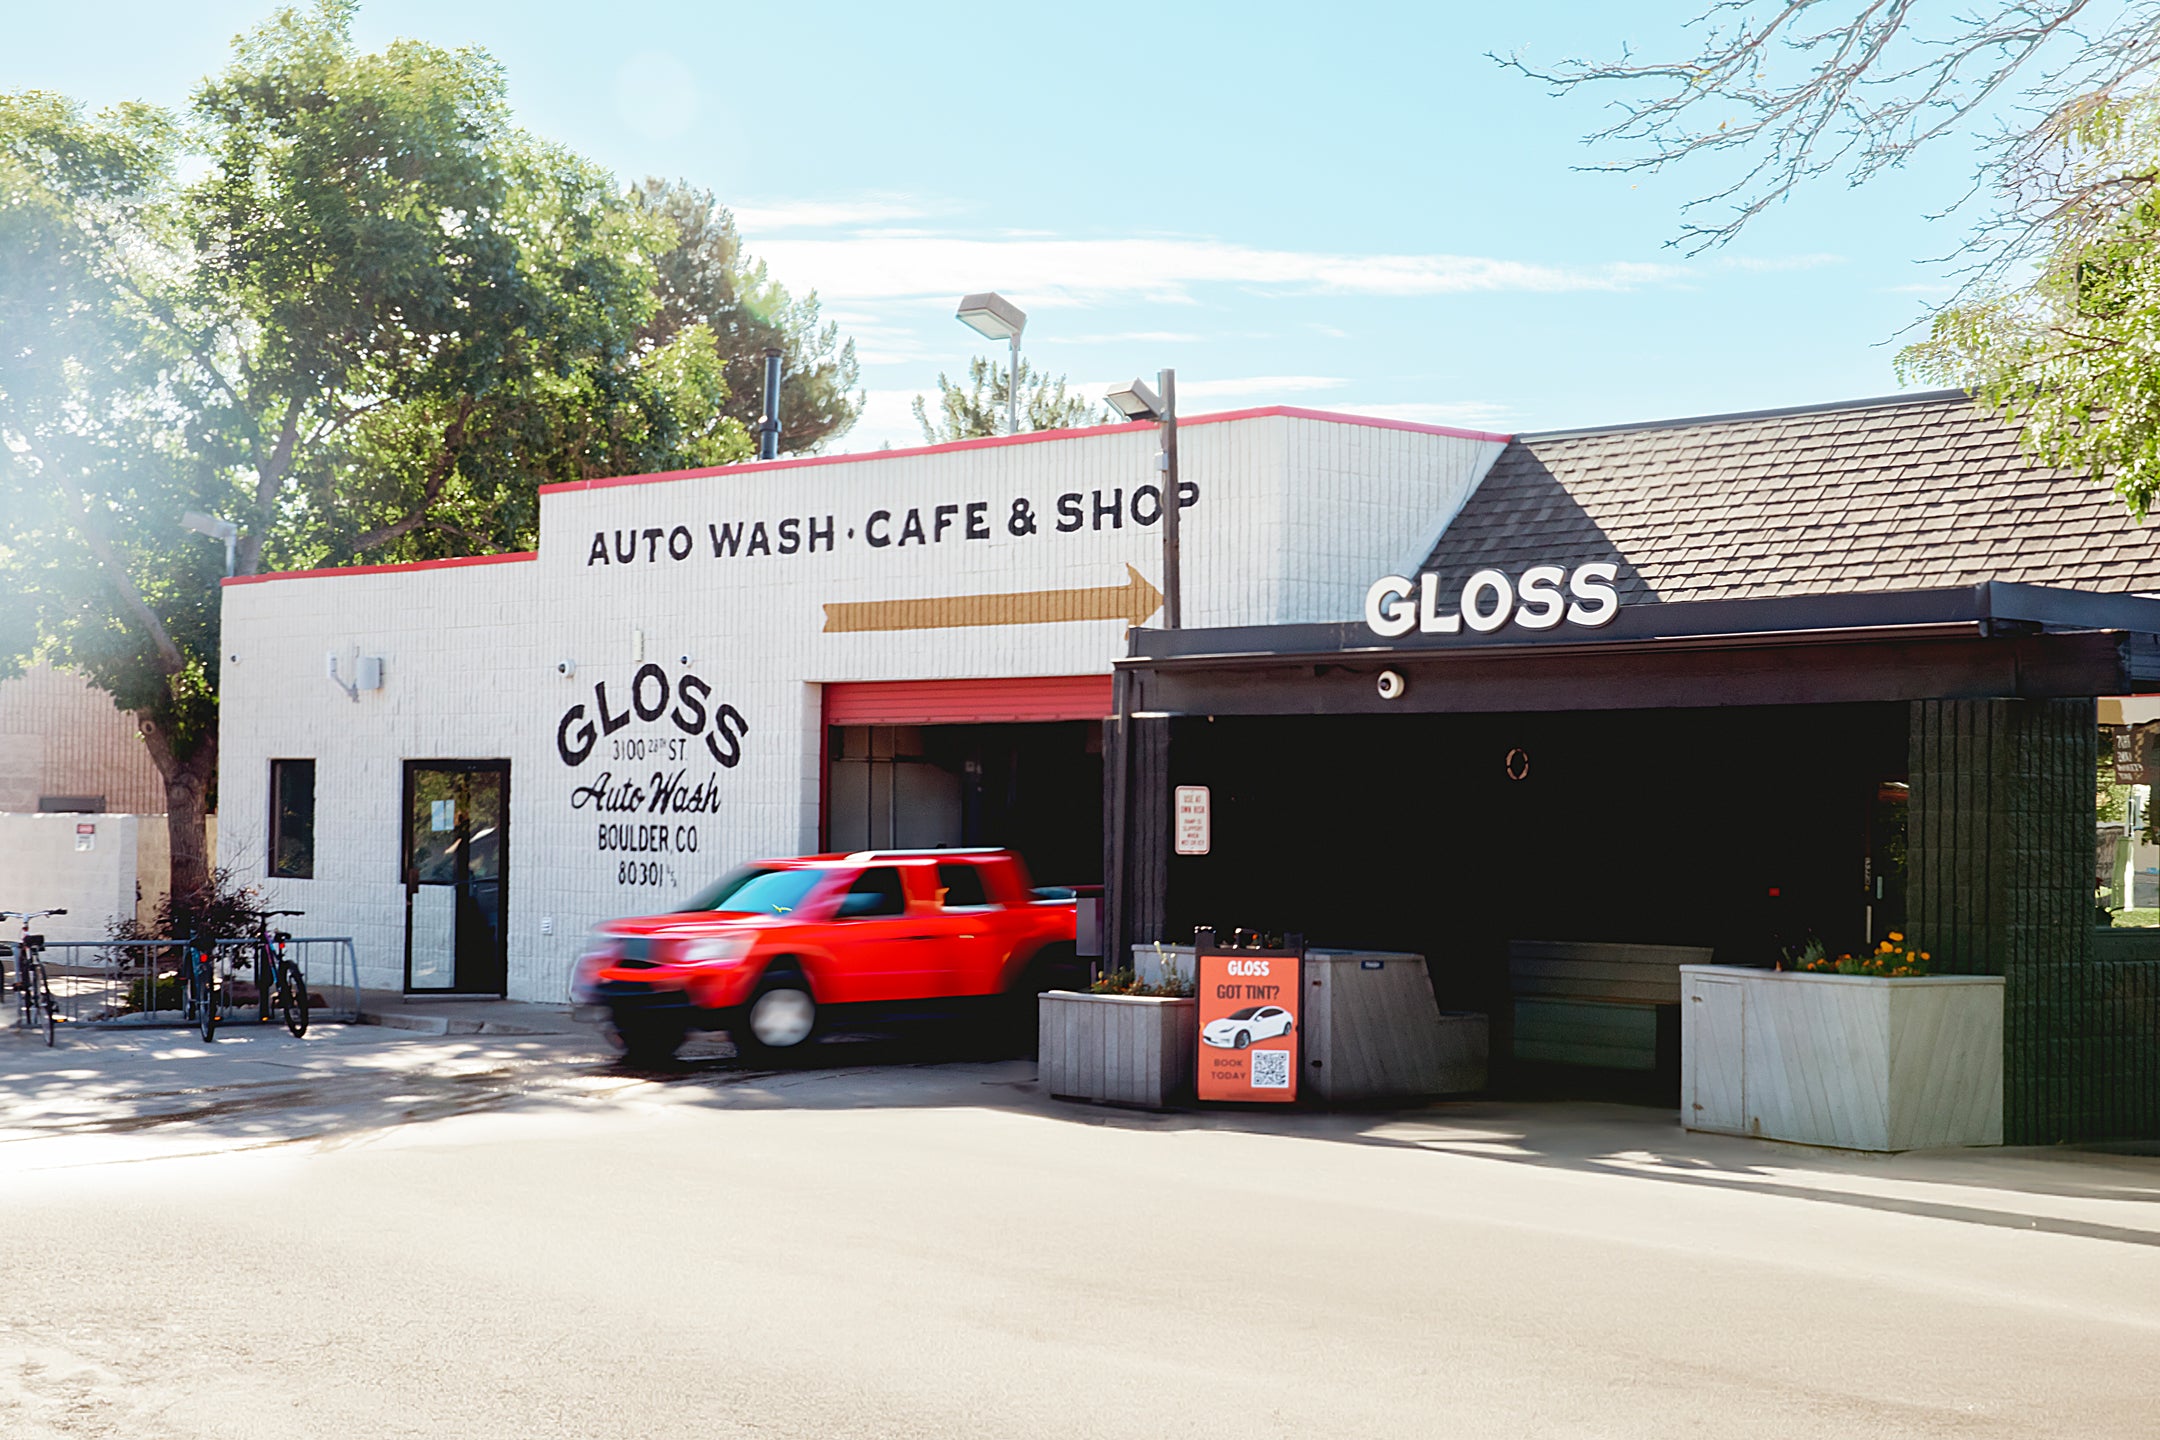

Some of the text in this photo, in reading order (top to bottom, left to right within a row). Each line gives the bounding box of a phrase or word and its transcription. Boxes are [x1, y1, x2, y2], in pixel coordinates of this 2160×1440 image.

[588, 525, 693, 566] AUTO
[709, 515, 835, 558] WASH
[865, 501, 991, 548] CAFE
[1007, 497, 1037, 537] &
[1365, 562, 1621, 638] GLOSS
[557, 663, 749, 768] GLOSS
[613, 738, 645, 761] 3100
[571, 768, 721, 815] Auto Wash
[618, 860, 663, 887] 80301
[1227, 960, 1270, 976] GLOSS
[1216, 984, 1280, 1000] GOT TINT?
[1211, 1071, 1246, 1079] TODAY
[1213, 1059, 1243, 1067] BOOK
